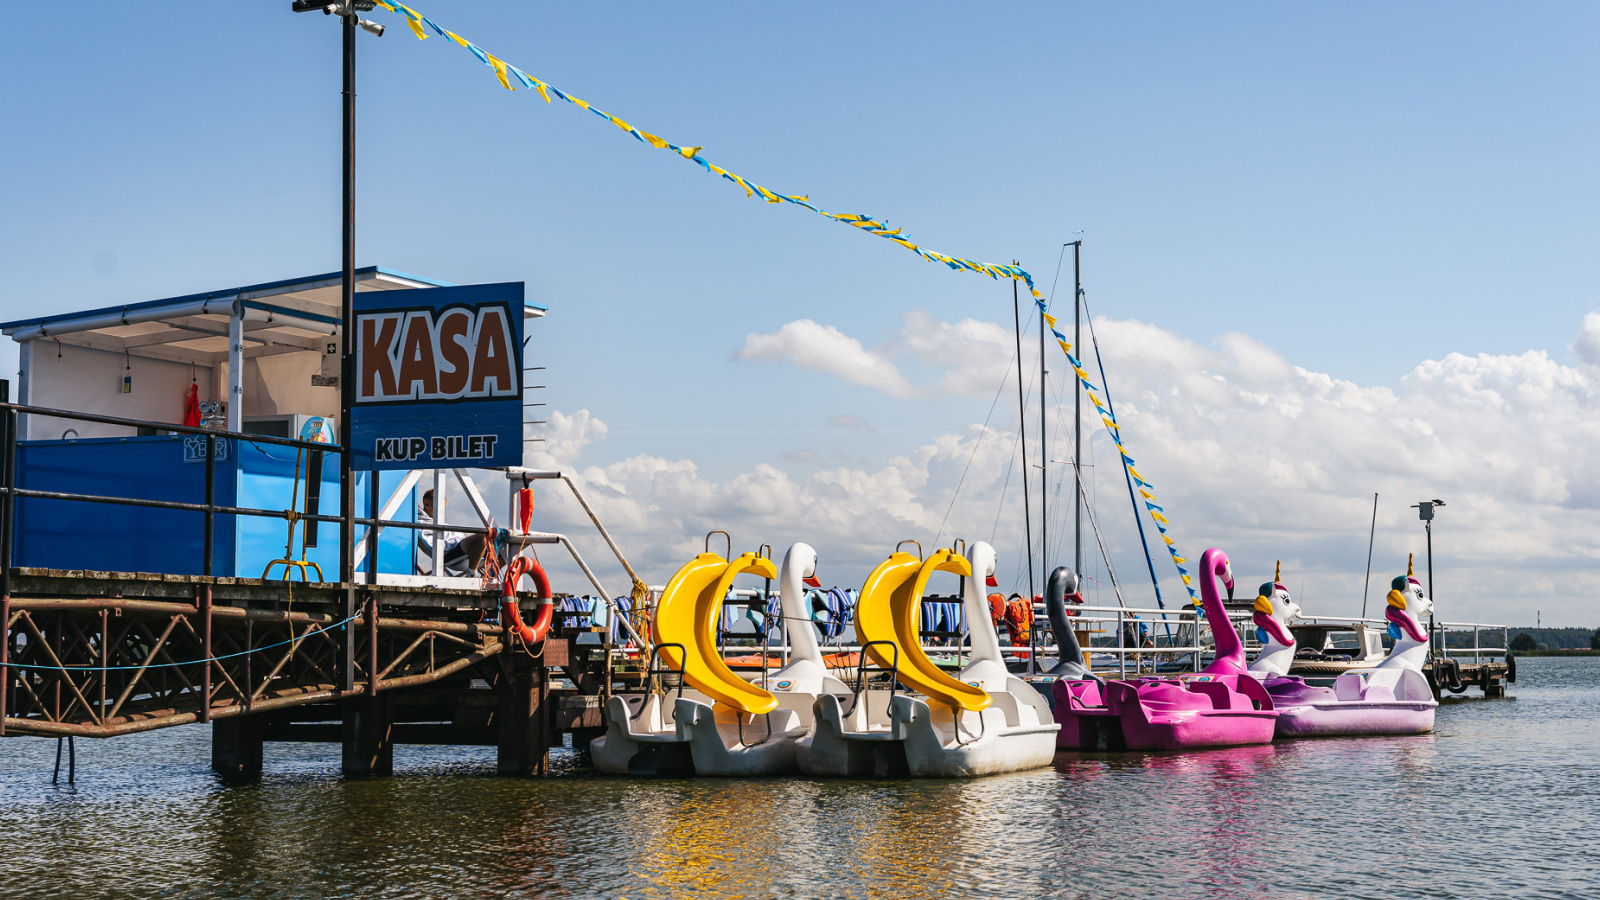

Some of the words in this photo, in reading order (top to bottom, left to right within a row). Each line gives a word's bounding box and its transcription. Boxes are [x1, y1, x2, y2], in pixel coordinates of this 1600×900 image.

[356, 306, 518, 402] KASA
[198, 442, 224, 457] BR
[376, 437, 426, 461] KUP
[431, 434, 497, 460] BILET
